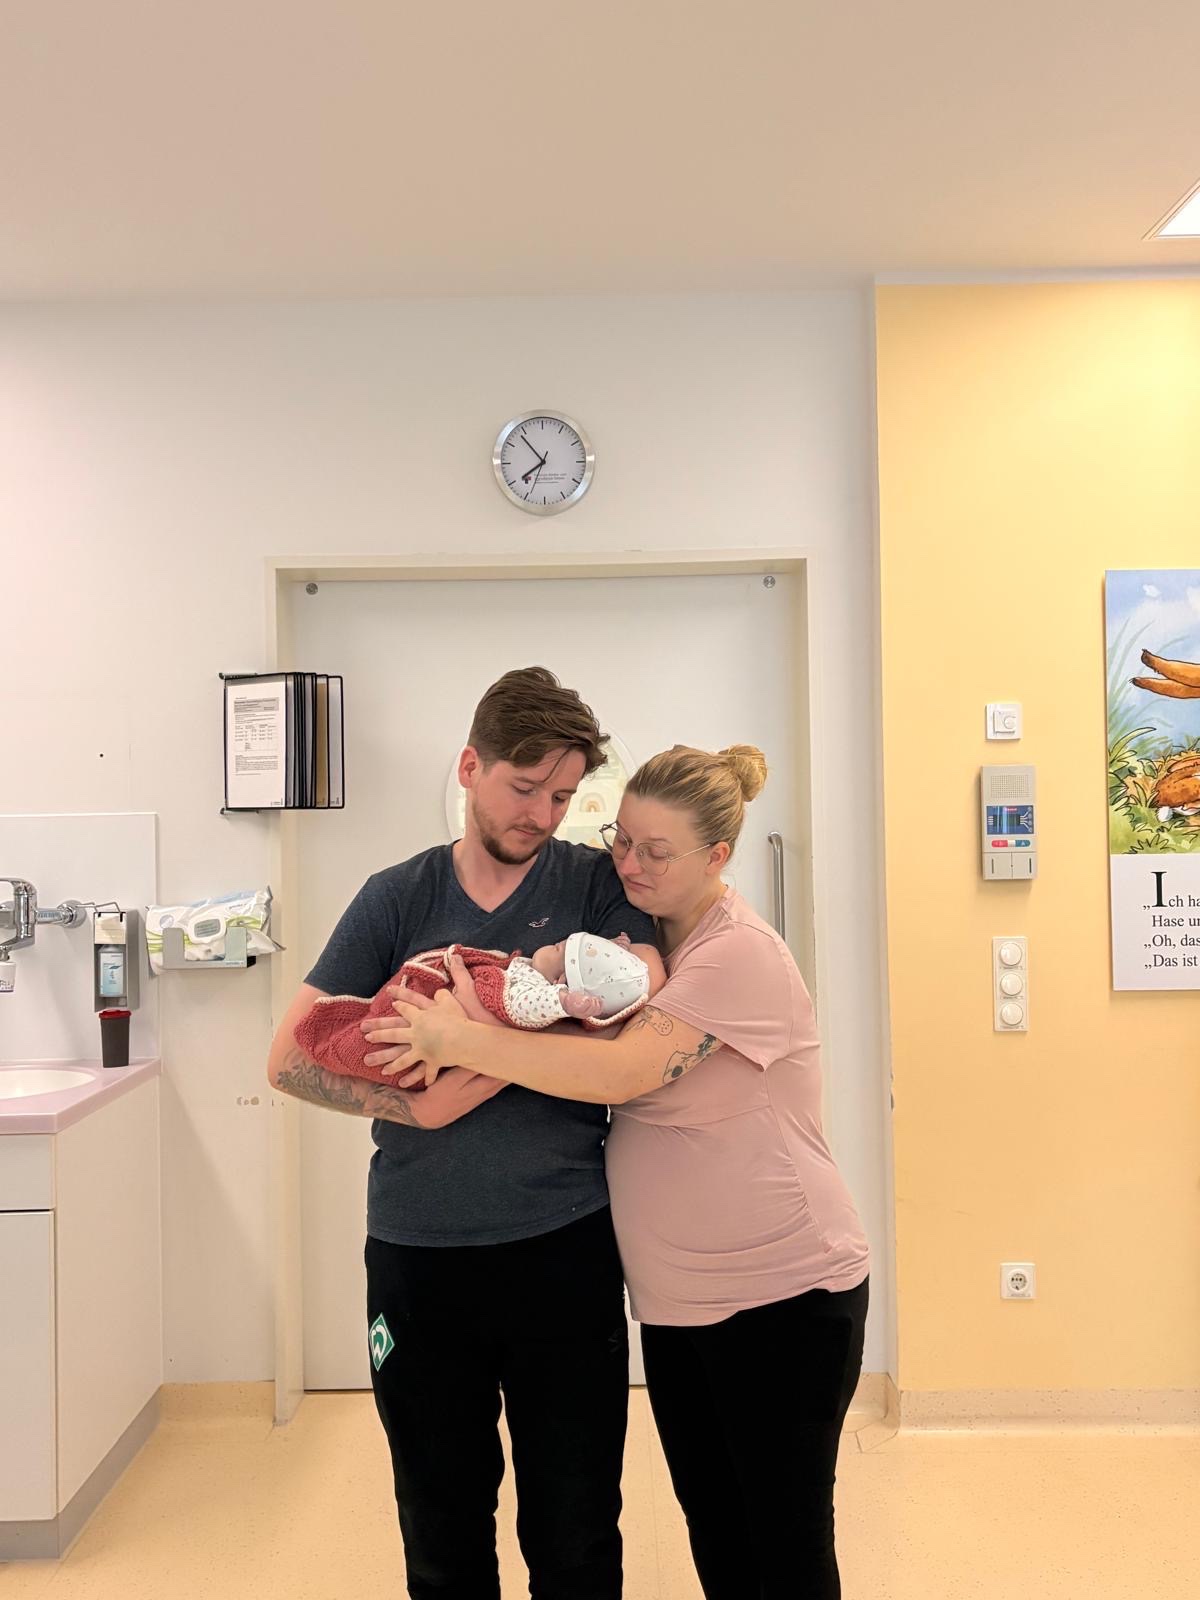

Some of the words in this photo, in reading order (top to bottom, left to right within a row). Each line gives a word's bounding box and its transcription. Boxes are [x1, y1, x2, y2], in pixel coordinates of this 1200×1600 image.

[1152, 915, 1184, 927] Hase
[1180, 934, 1200, 946] das
[1182, 954, 1198, 966] ist
